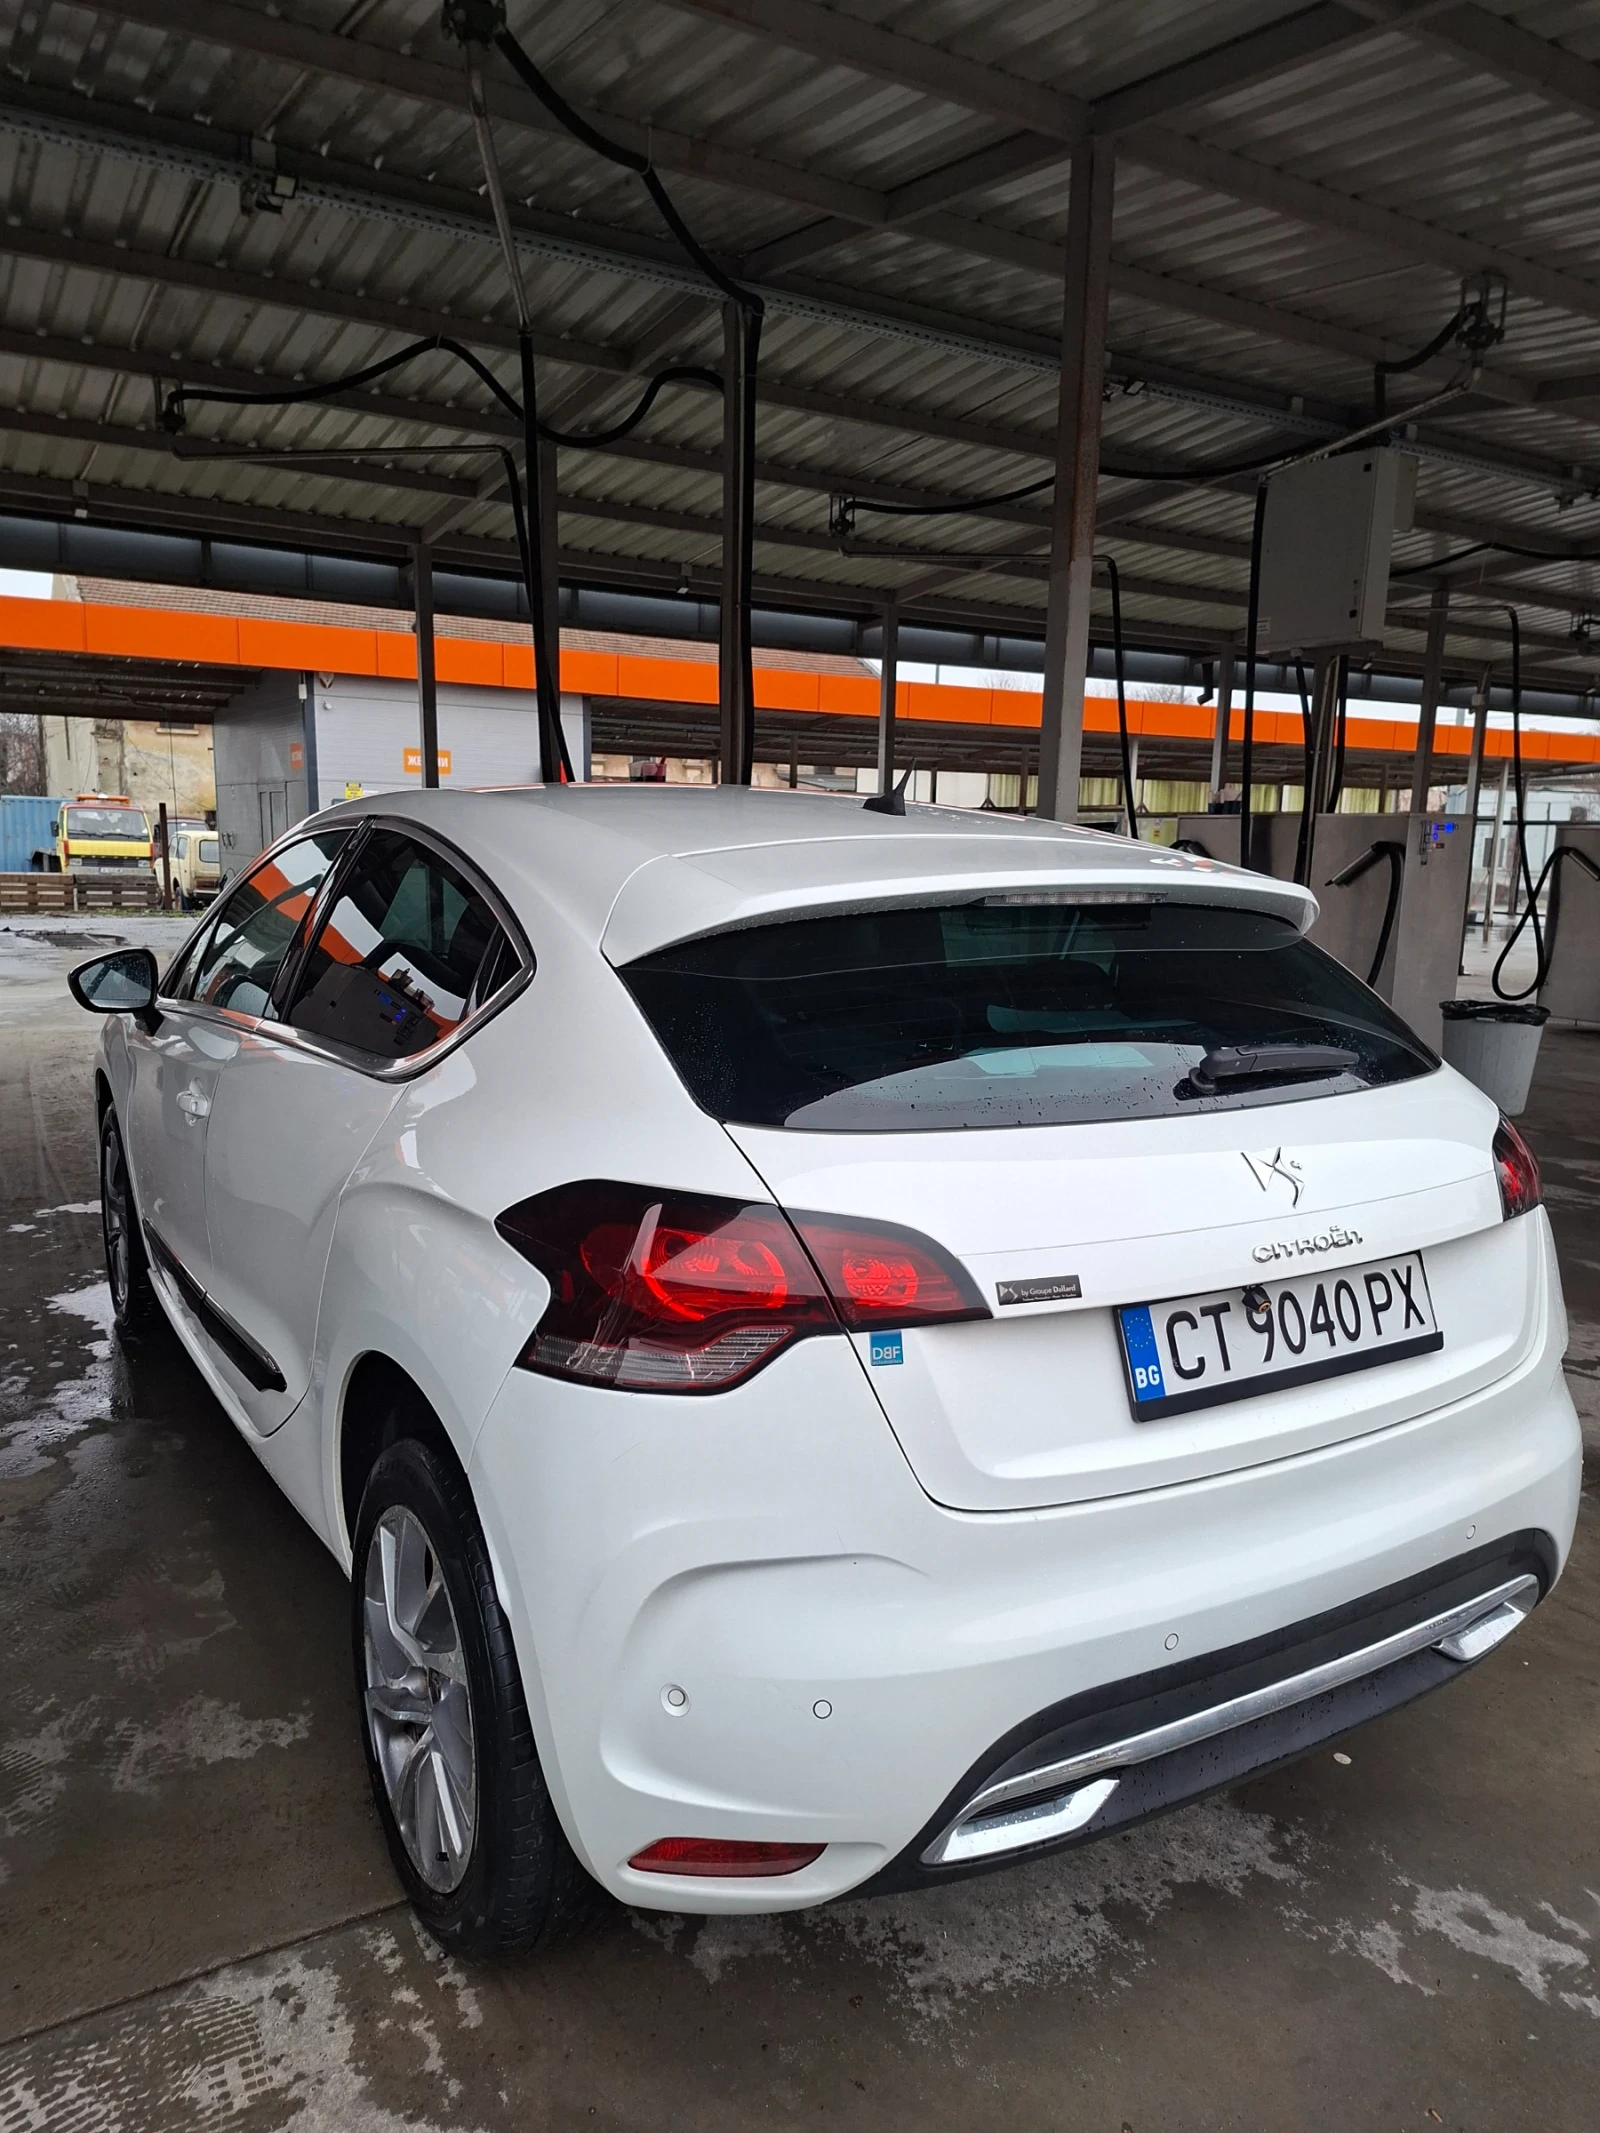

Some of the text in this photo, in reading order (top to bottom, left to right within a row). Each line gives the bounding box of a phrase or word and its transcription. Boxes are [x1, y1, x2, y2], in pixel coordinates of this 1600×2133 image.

[1252, 1226, 1363, 1263] CITROËN
[1021, 1288, 1029, 1297] by
[1029, 1288, 1052, 1296] Groupe
[1052, 1284, 1076, 1293] Dallard
[1166, 1265, 1425, 1380] CT 9040 PX
[873, 1346, 901, 1360] DBF
[1135, 1365, 1160, 1389] BG
